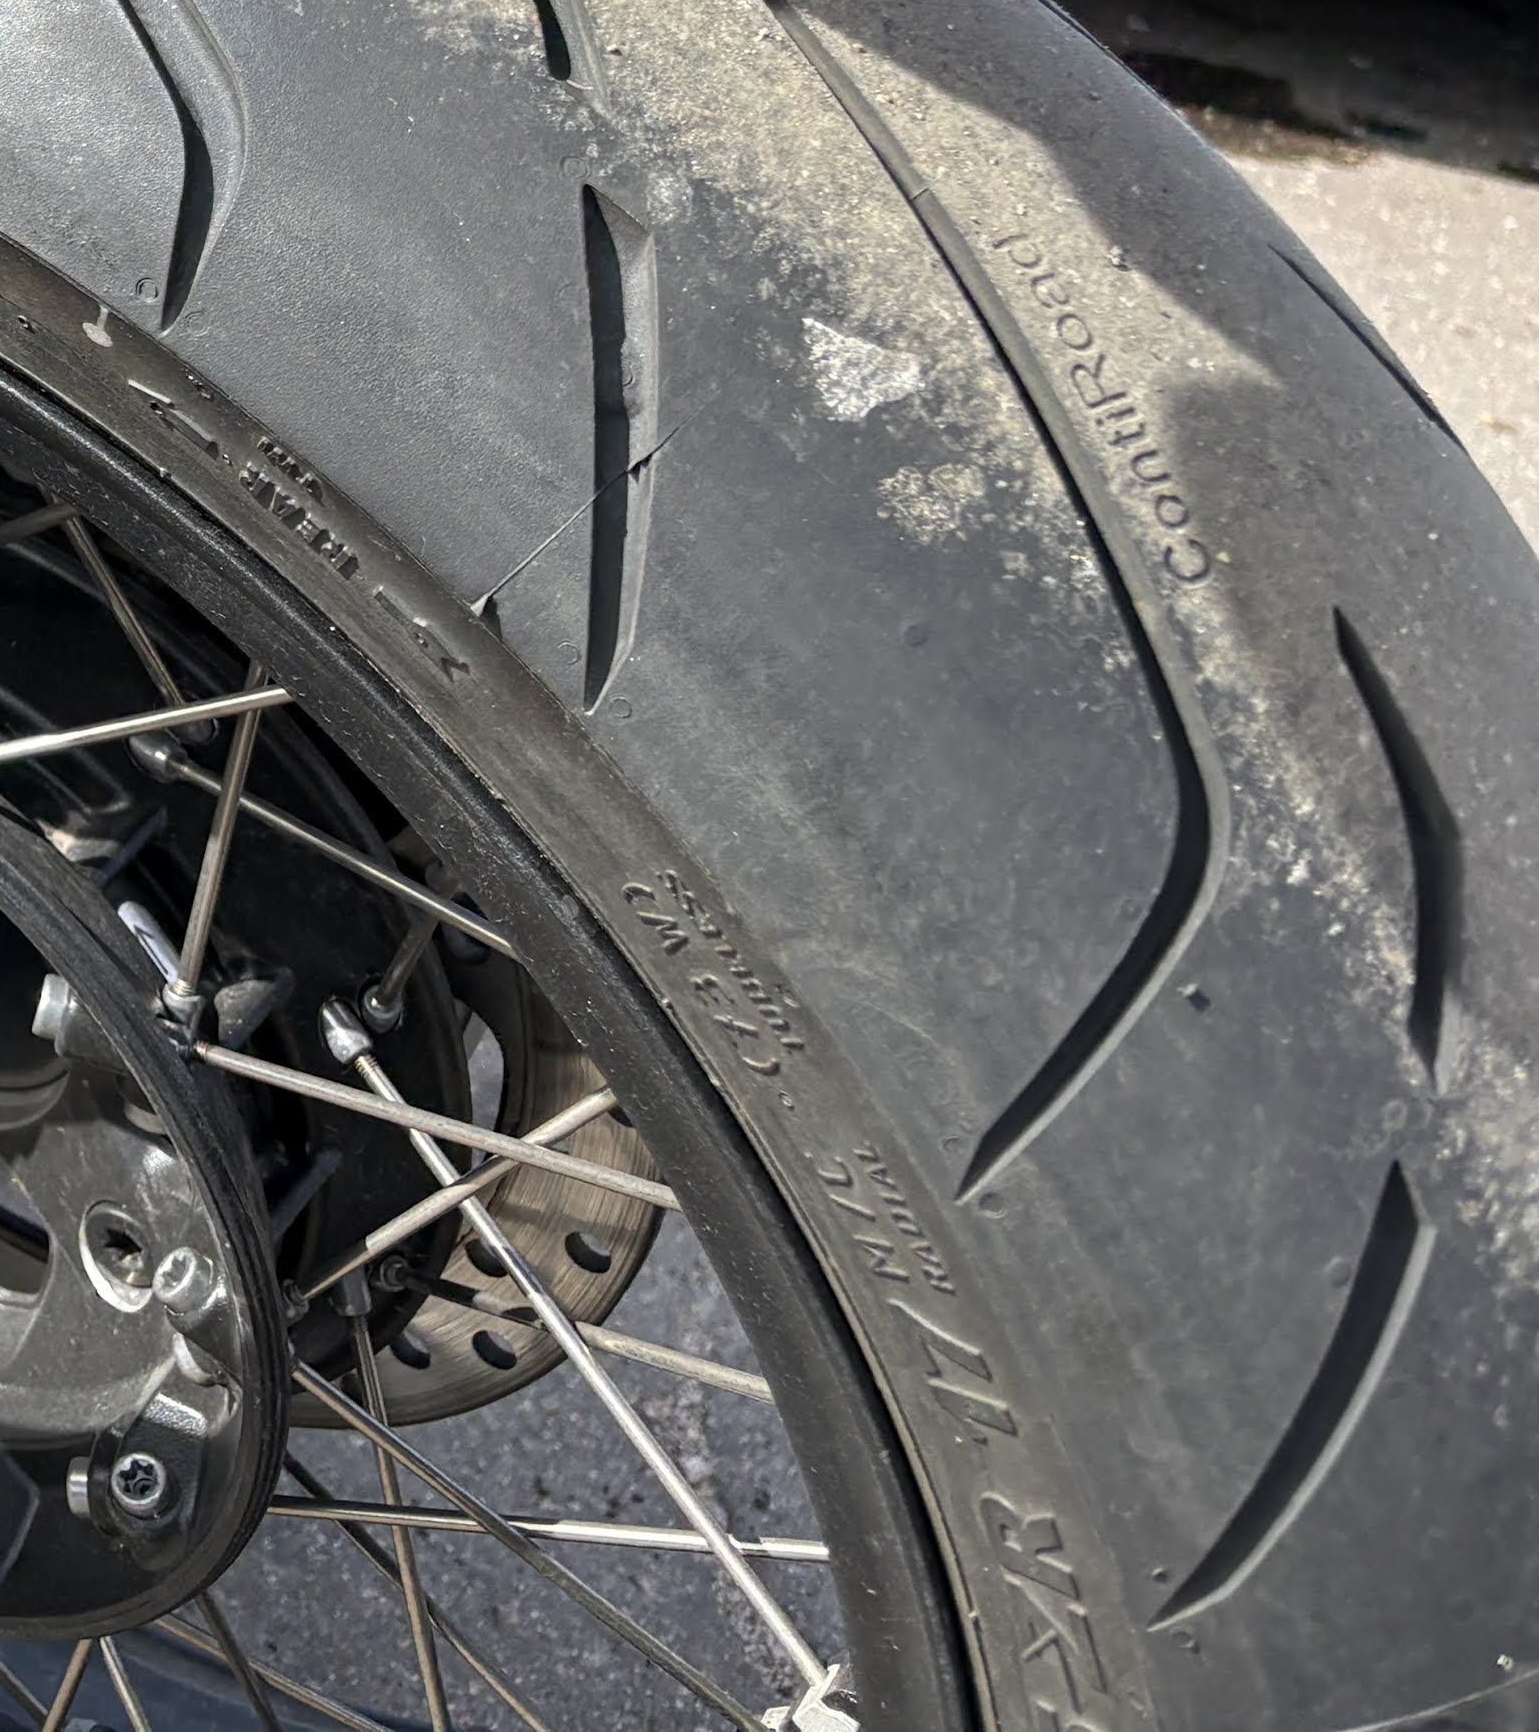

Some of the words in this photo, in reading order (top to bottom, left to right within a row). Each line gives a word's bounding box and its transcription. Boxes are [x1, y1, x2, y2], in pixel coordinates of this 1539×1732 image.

[992, 233, 1212, 585] ContiRoad
[238, 462, 355, 573] REAR
[851, 1144, 957, 1296] RADIAL
